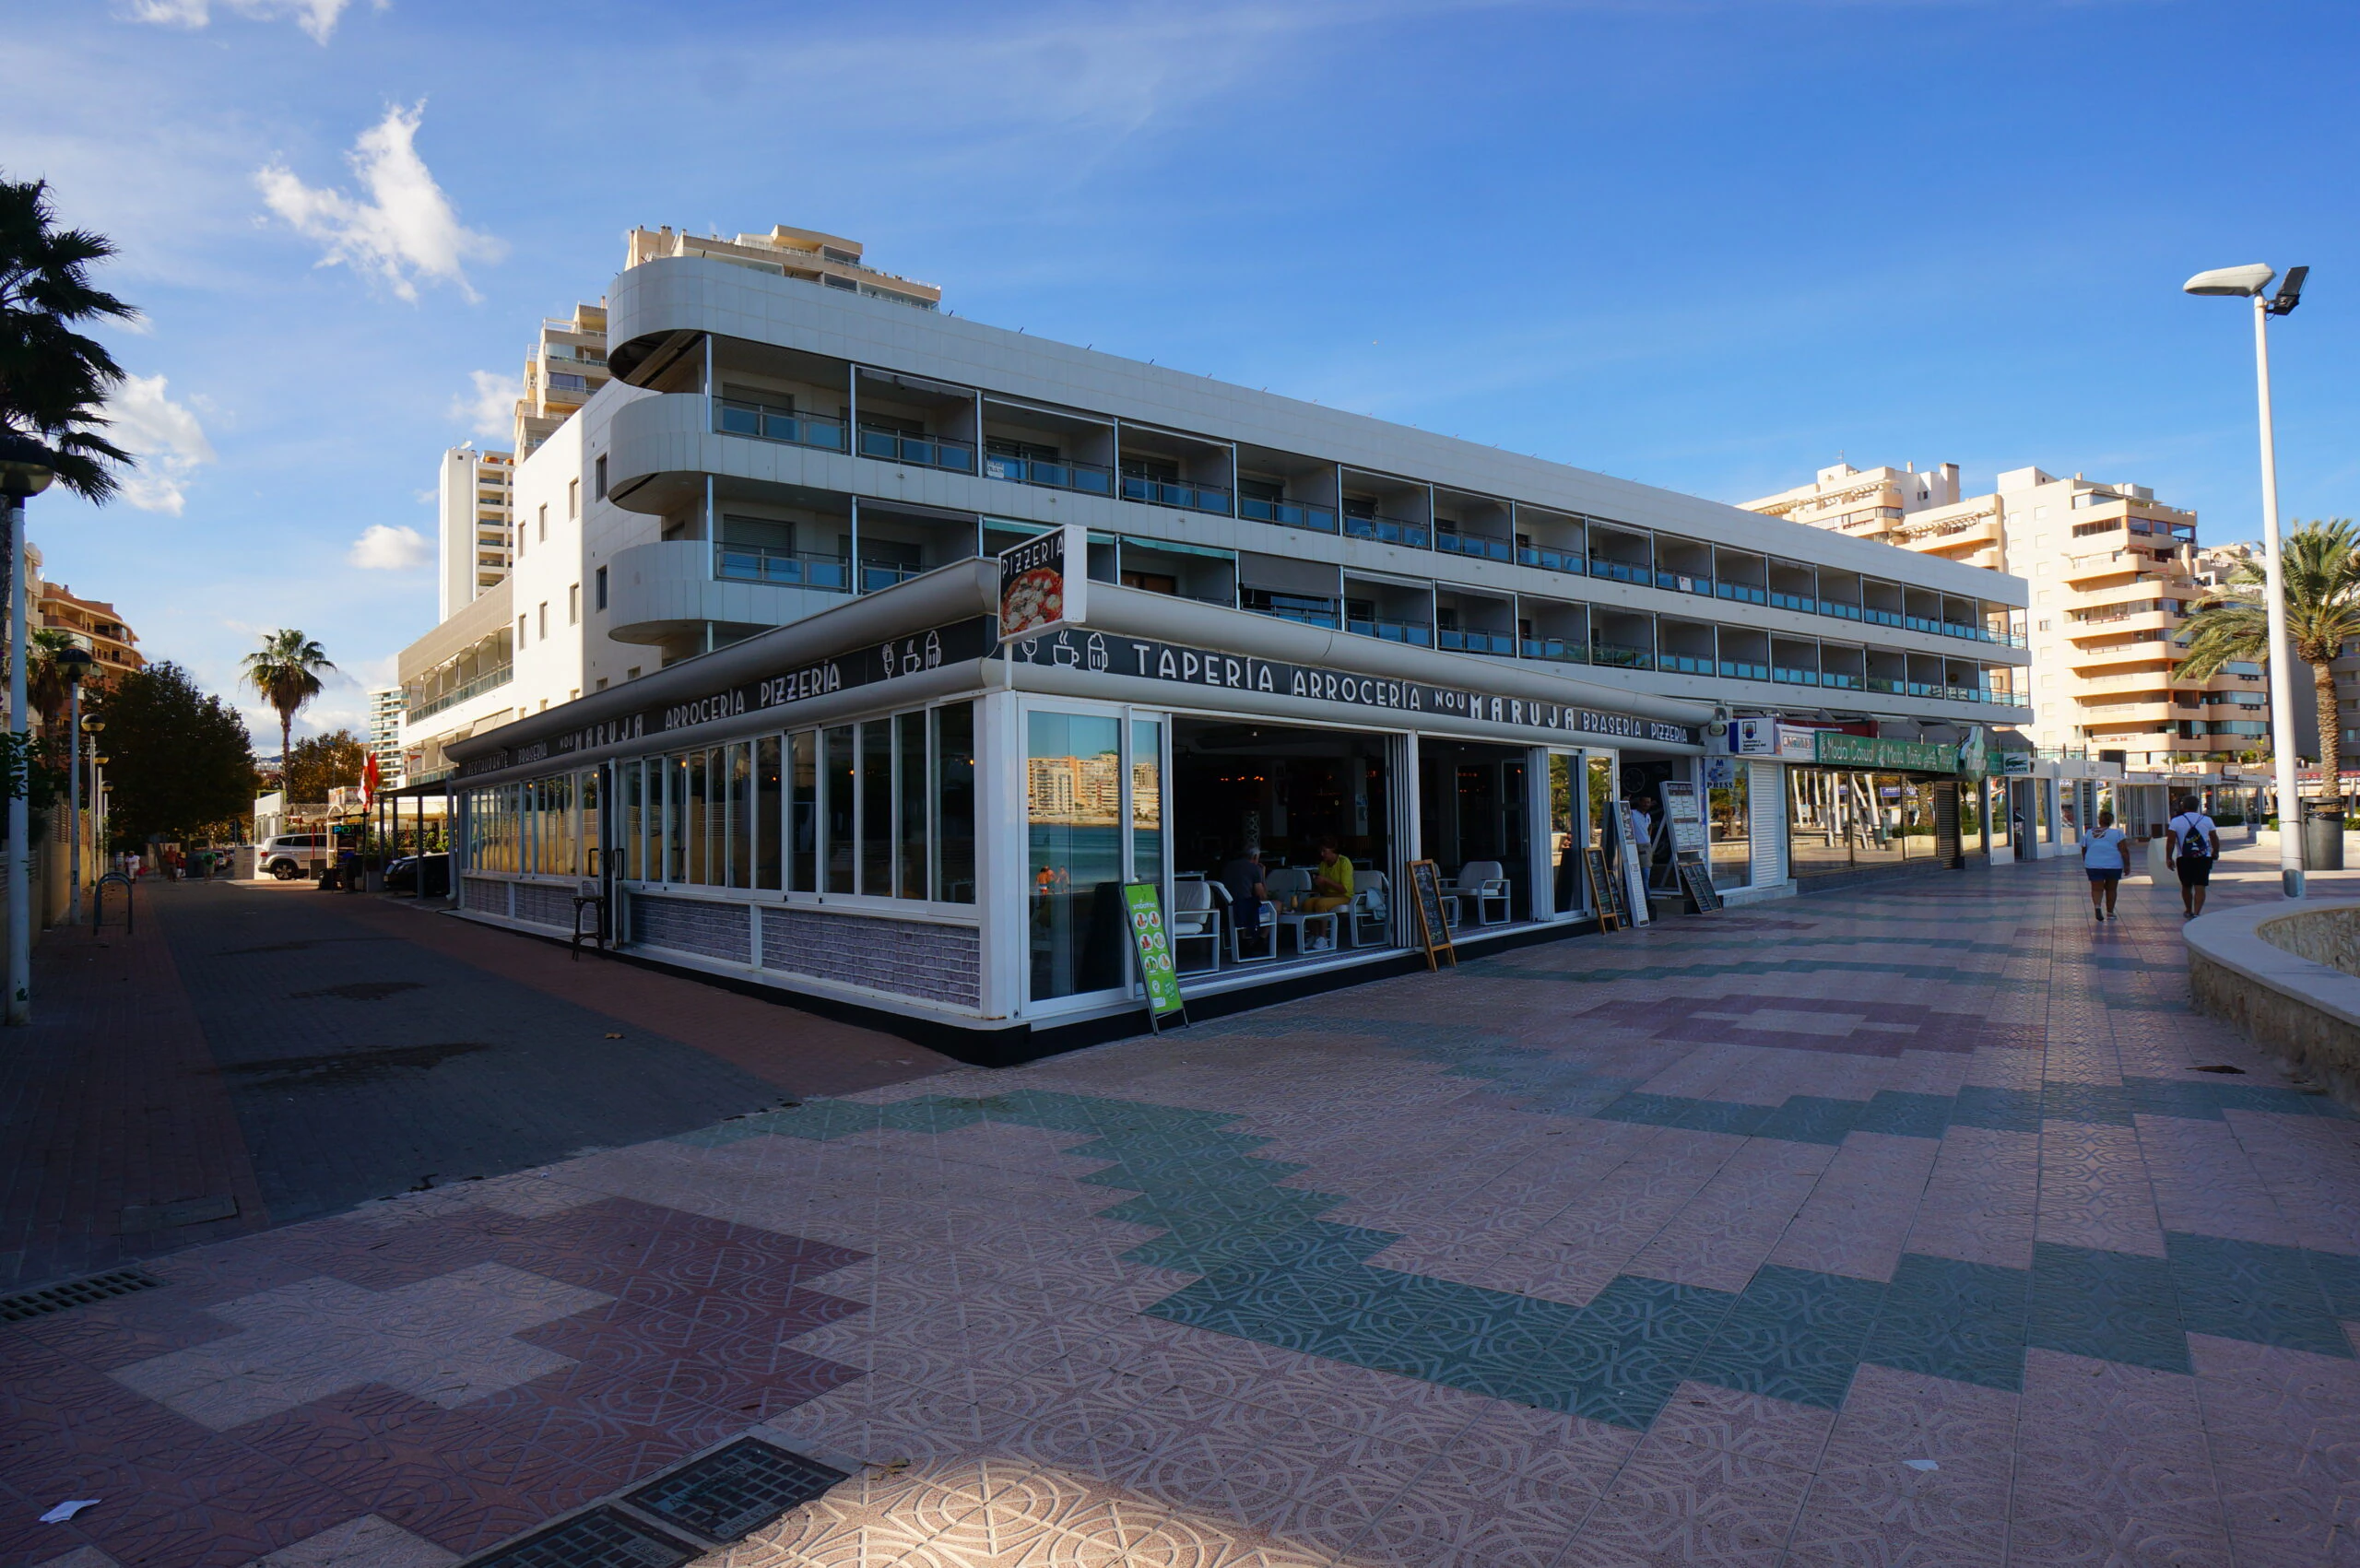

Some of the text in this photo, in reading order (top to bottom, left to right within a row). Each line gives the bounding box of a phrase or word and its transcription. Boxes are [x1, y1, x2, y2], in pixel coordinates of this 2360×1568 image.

[1002, 536, 1065, 579] PIZZERIA
[574, 713, 644, 751] MARUJA
[665, 689, 745, 731] ARROCERÍA
[761, 659, 842, 708] PIZZERÍA
[1132, 644, 1688, 744] TAPERÍA ARROCERÍA NOU MARUJA BRASERÍA PIZZERÍA
